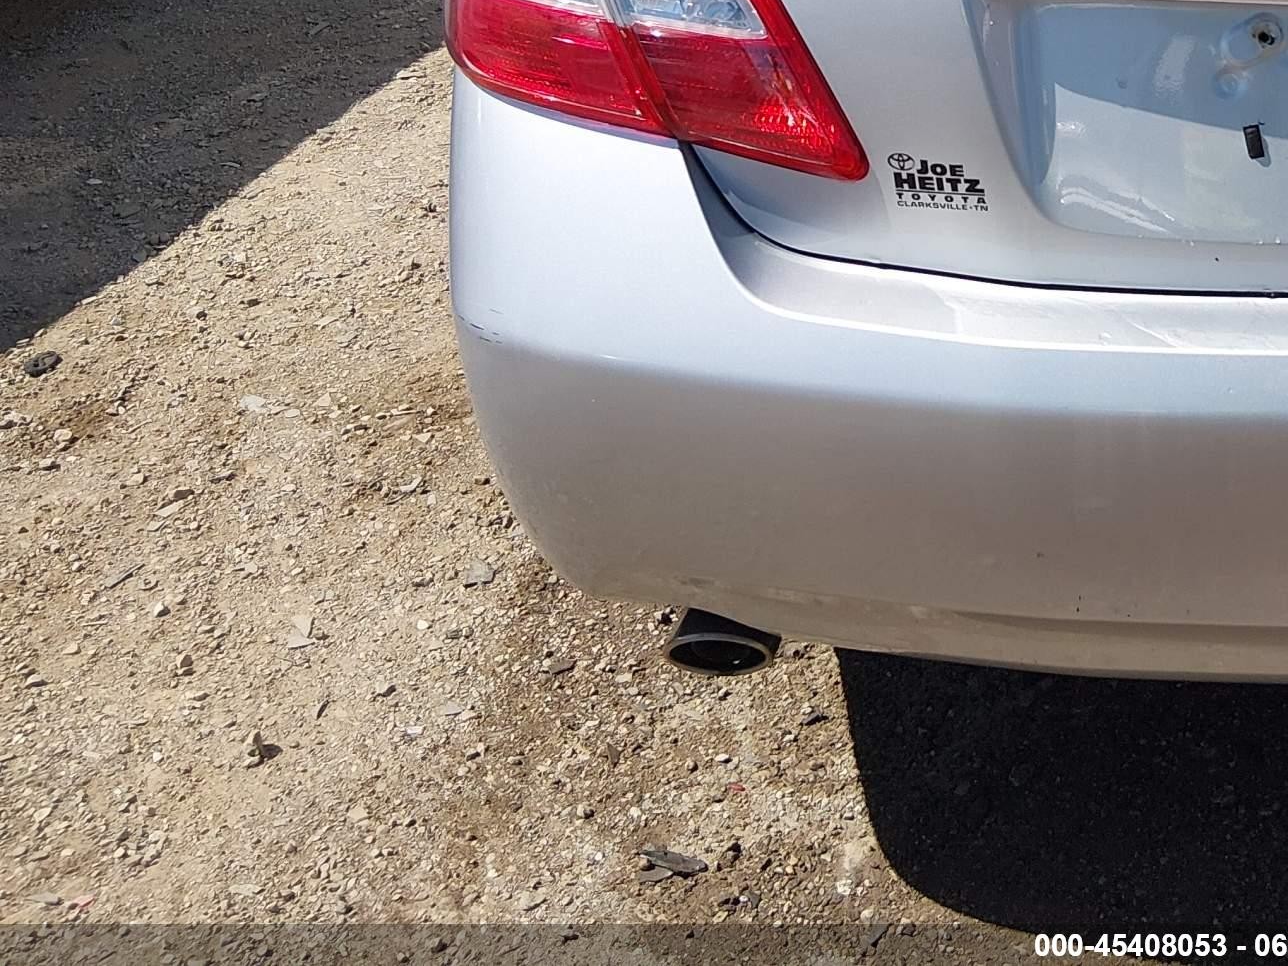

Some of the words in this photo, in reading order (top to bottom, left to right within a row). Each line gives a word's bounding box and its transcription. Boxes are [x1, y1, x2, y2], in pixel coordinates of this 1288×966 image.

[916, 159, 964, 177] JOE
[893, 172, 985, 194] HEITZ
[896, 192, 987, 204] TOYOTA
